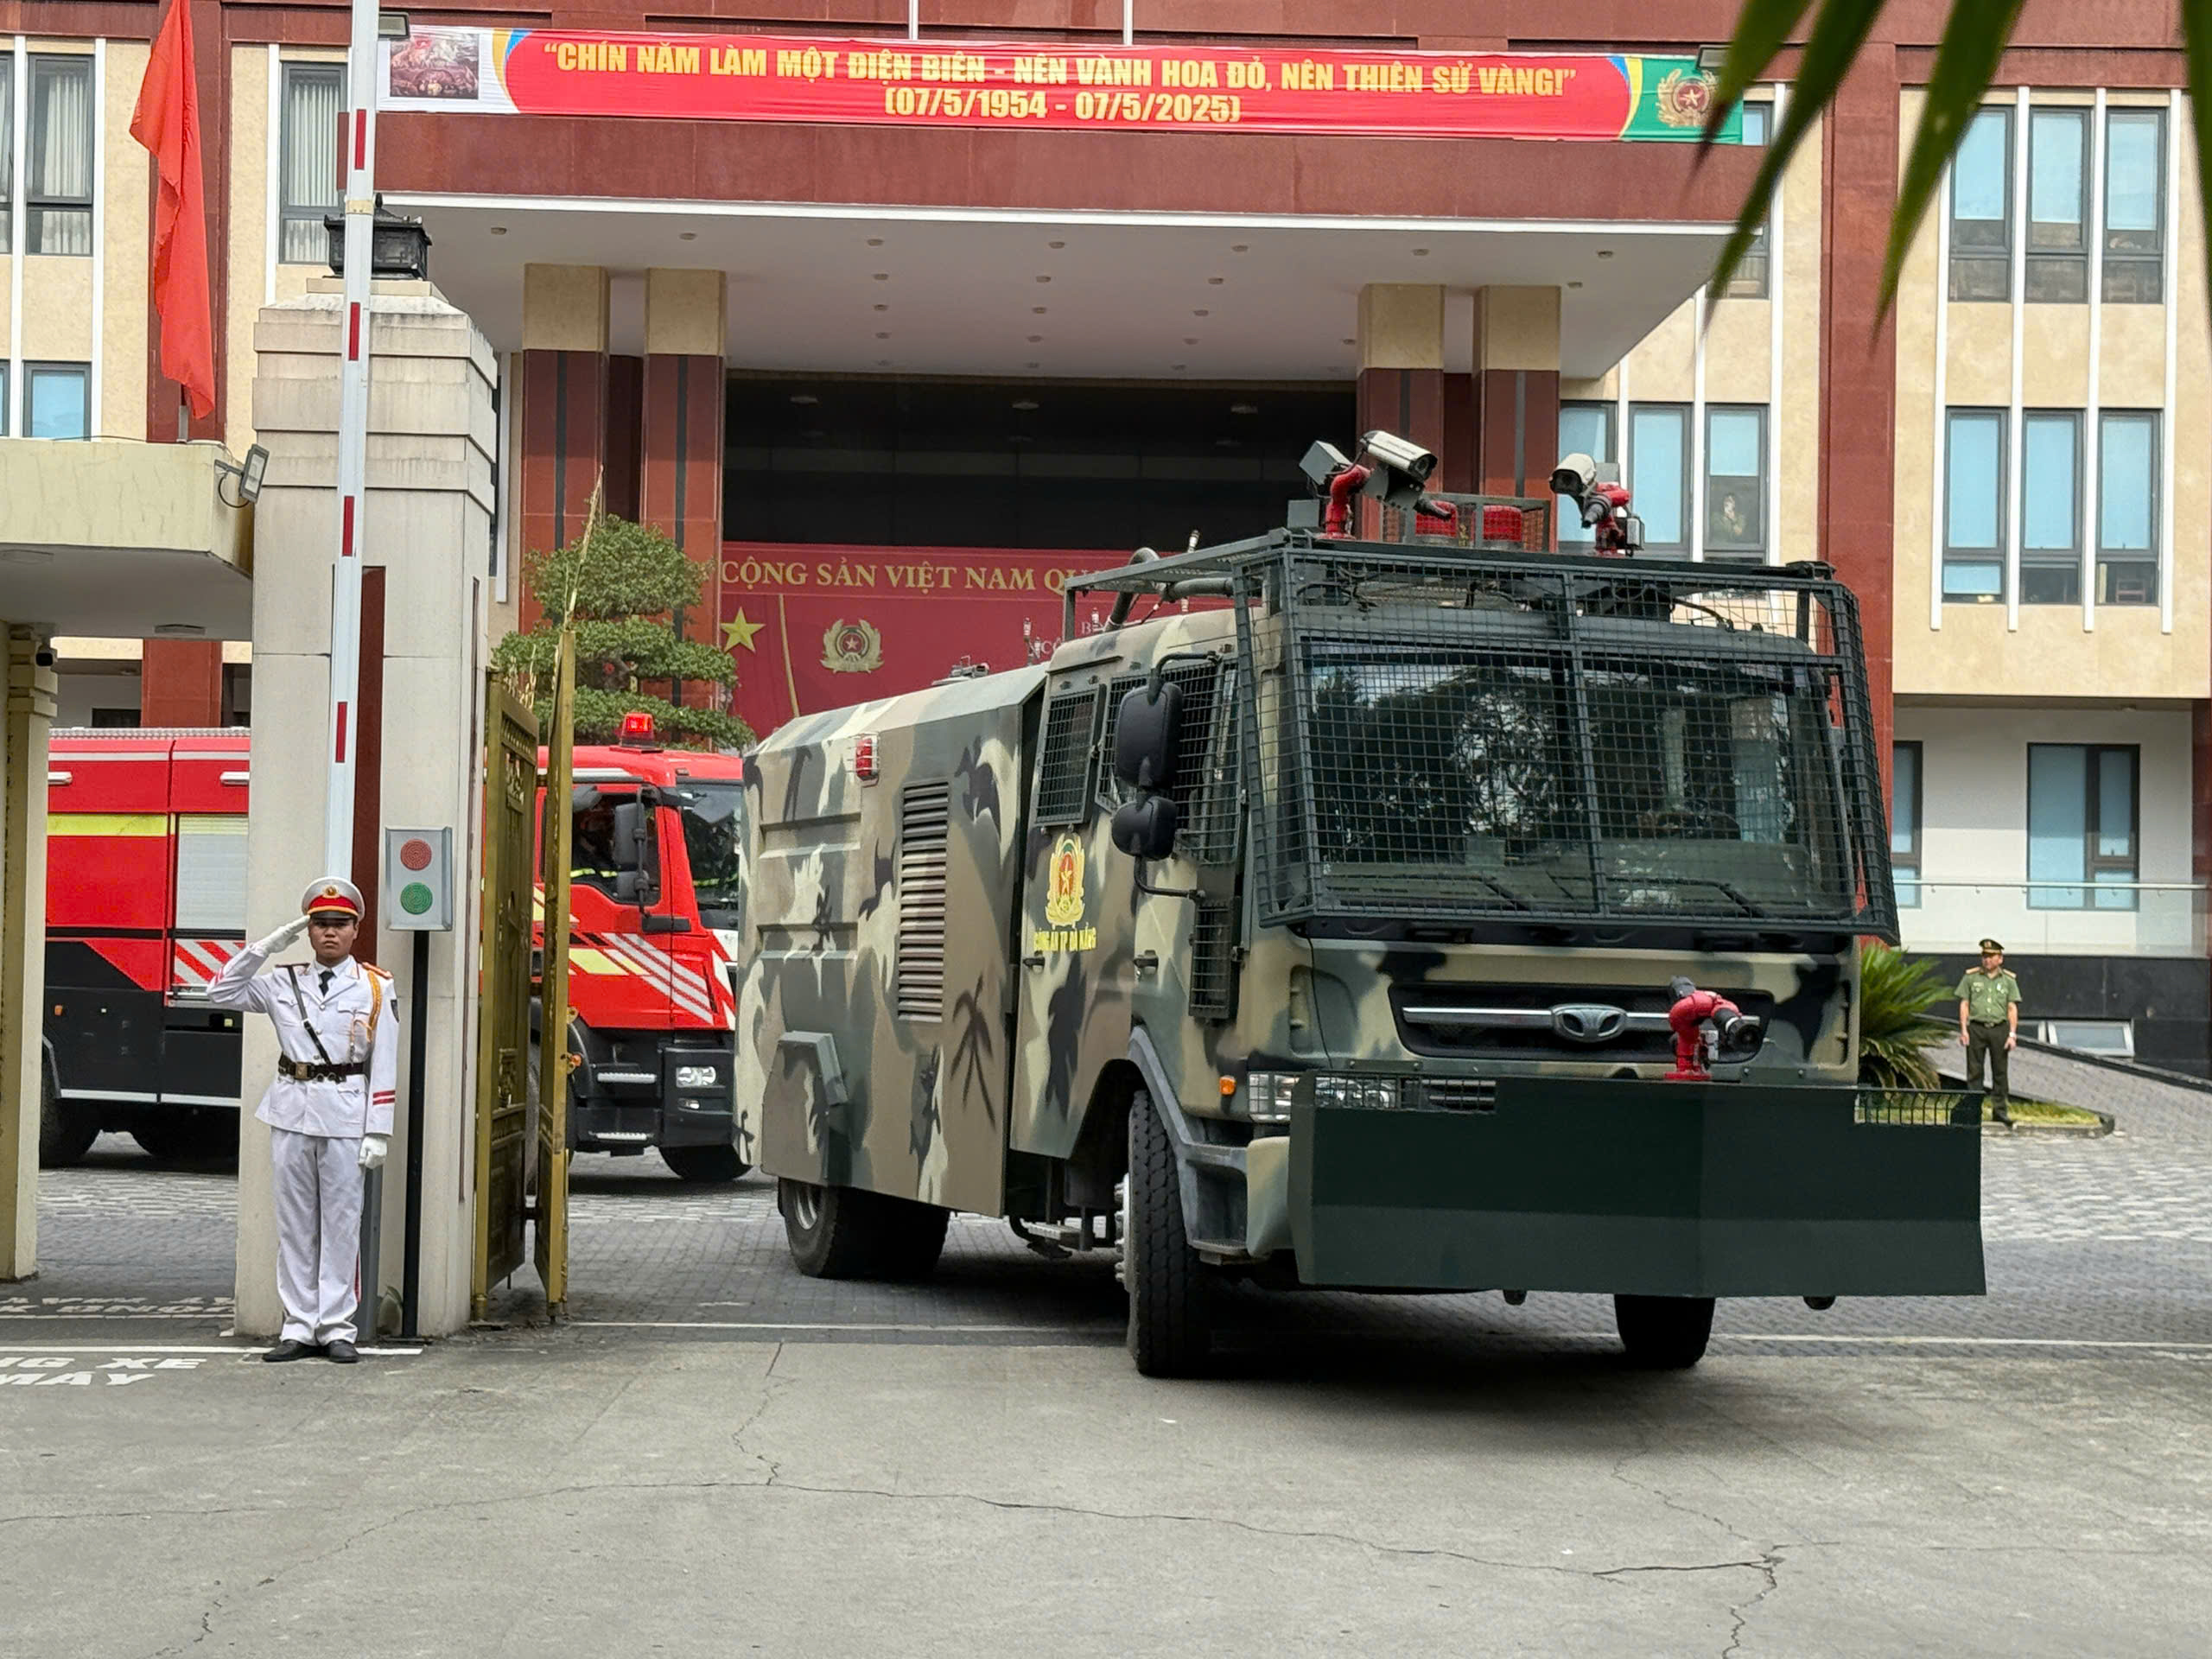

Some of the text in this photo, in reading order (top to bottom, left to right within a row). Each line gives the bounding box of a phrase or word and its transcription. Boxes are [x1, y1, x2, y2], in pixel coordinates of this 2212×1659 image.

[637, 41, 701, 74] NĂM
[709, 44, 767, 76] LÀM
[777, 47, 839, 83] MỘT
[847, 48, 912, 86] ĐIỆN
[921, 51, 985, 83] BIÊN
[1014, 53, 1067, 84] NÊN
[1075, 54, 1153, 86] VÀNH
[1161, 60, 1219, 88] HOA
[1226, 56, 1273, 92] ĐỎ,
[1281, 59, 1334, 90] NÊN
[1342, 60, 1423, 92] THIÊN
[1432, 60, 1473, 94] SỬ
[721, 556, 809, 590] CỘNG
[817, 556, 878, 588] SẢN
[885, 561, 957, 594] VIỆT
[964, 567, 1037, 591] NAM
